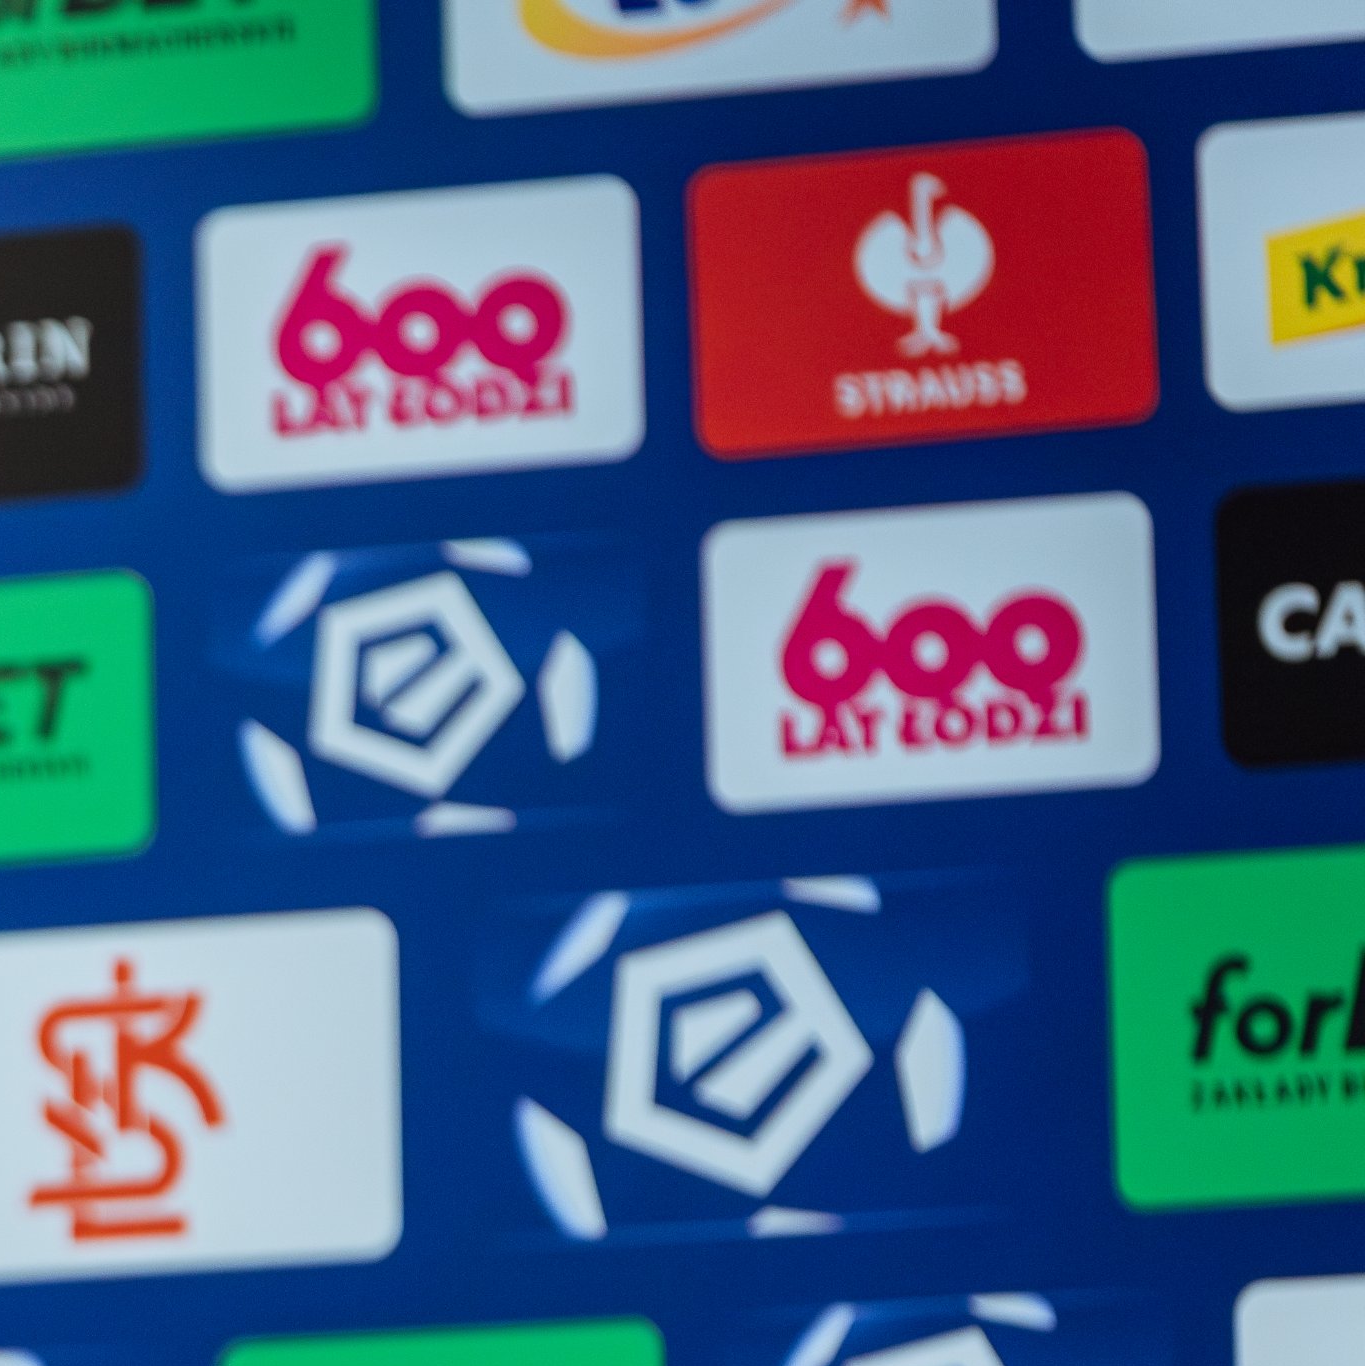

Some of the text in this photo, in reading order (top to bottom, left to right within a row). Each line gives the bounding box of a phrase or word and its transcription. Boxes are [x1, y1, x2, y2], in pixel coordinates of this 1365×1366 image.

[271, 240, 573, 388] 600
[833, 358, 1027, 418] STRAUSS
[779, 554, 1087, 708] 600
